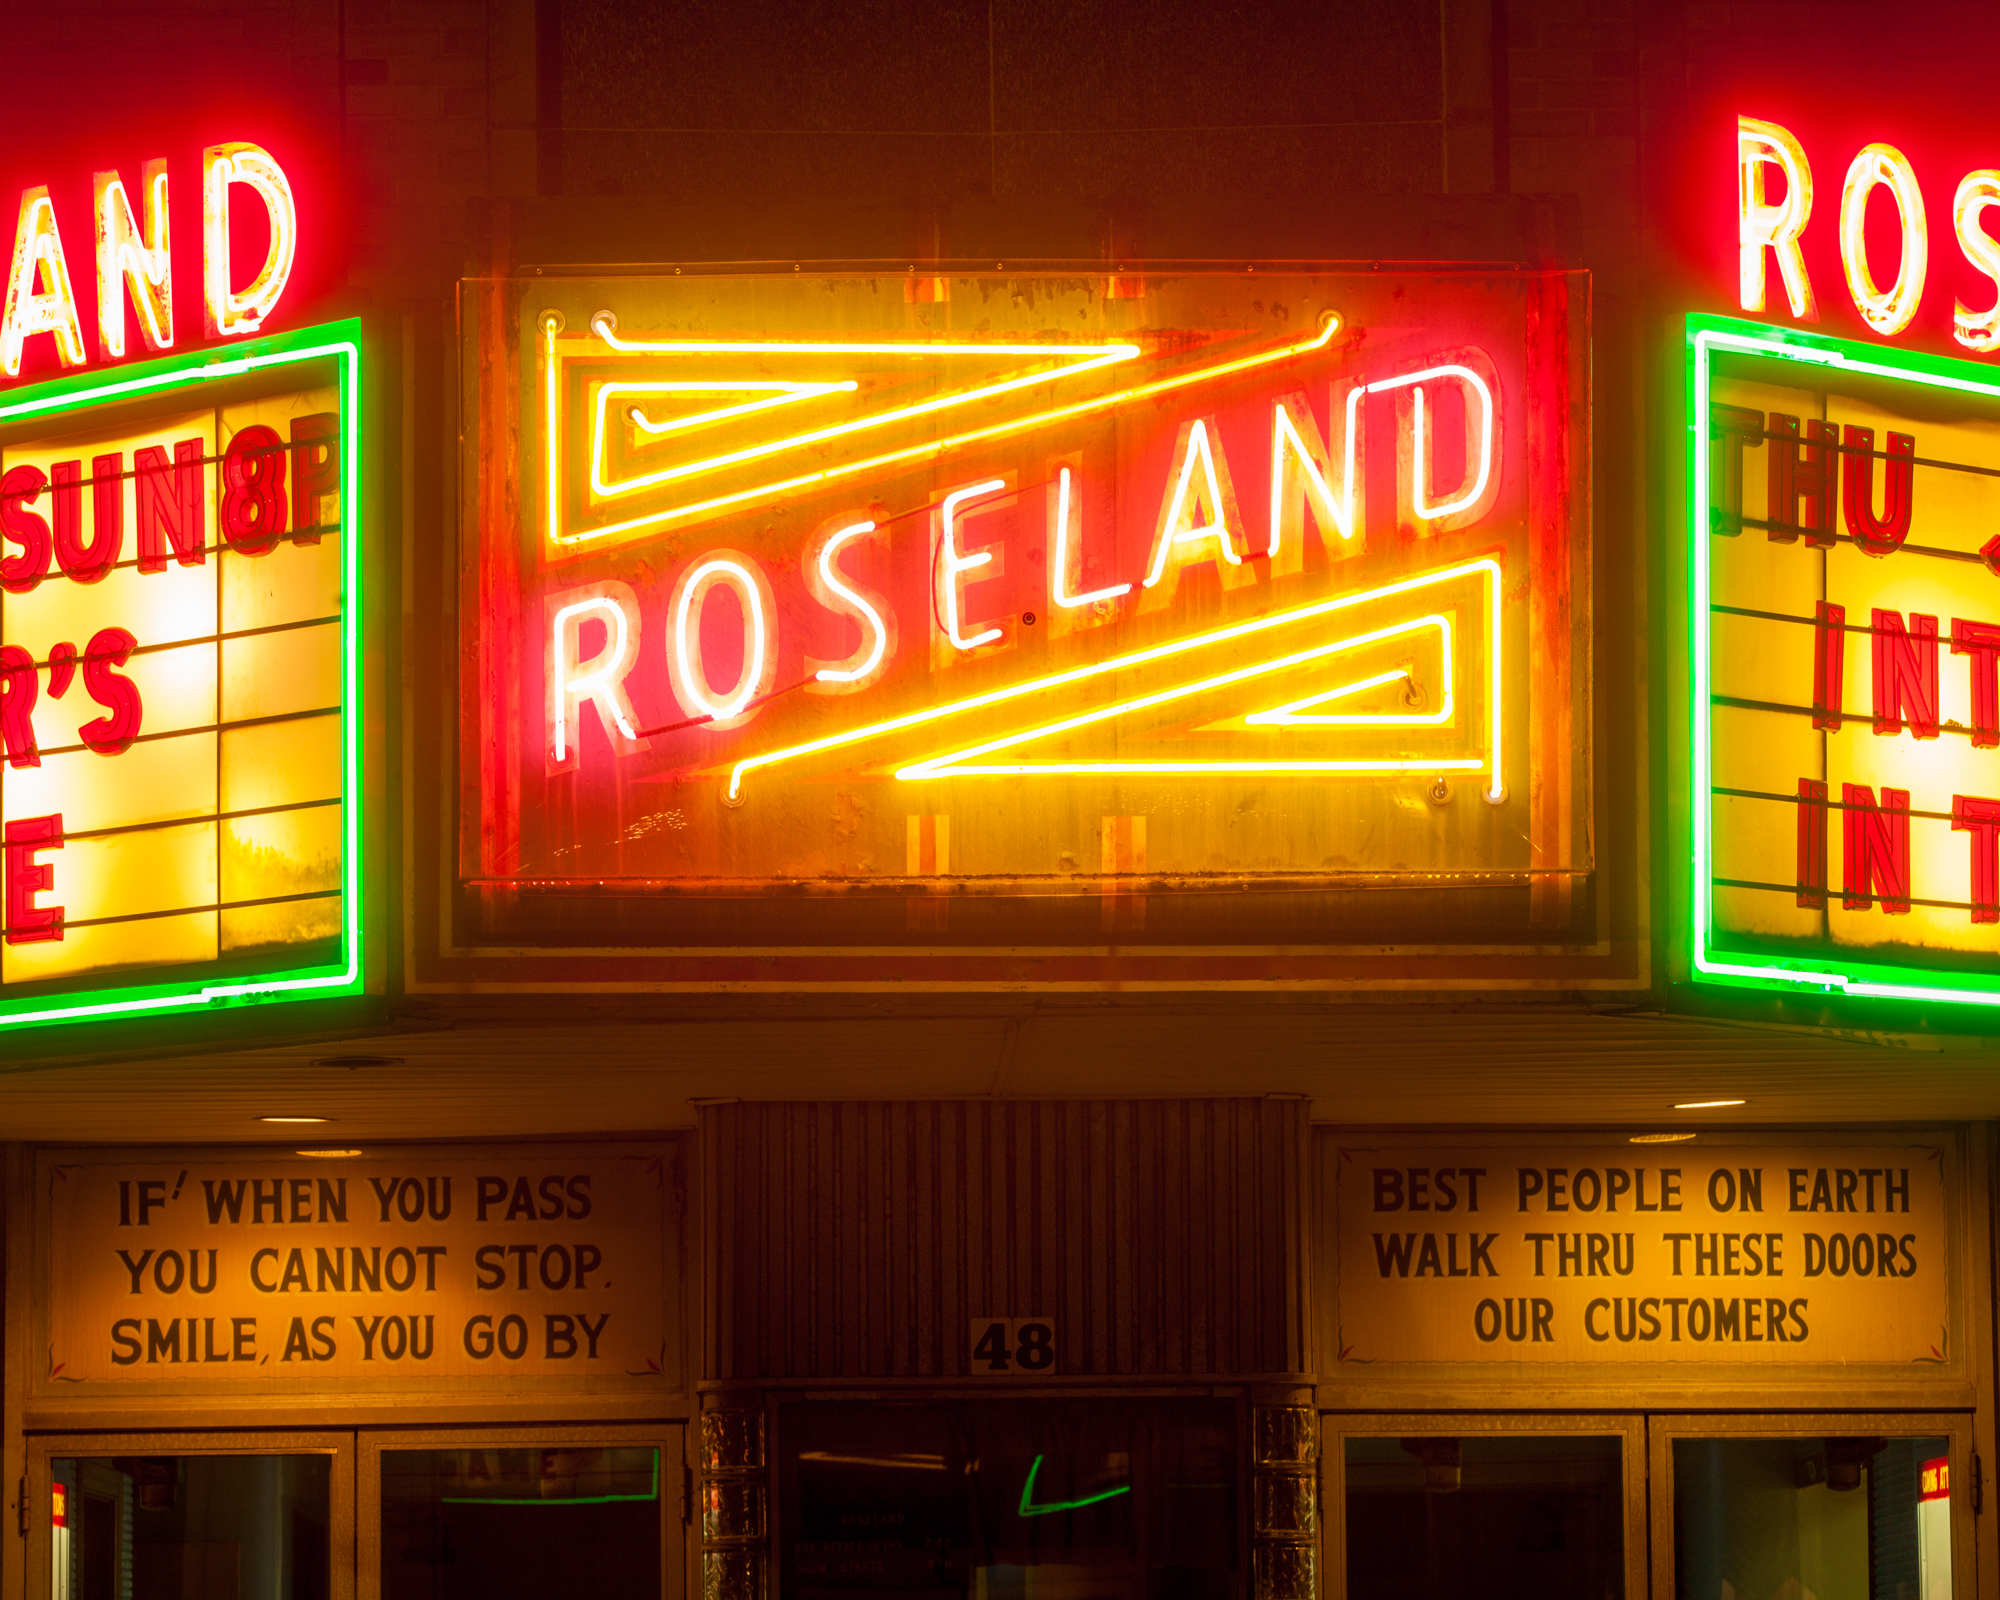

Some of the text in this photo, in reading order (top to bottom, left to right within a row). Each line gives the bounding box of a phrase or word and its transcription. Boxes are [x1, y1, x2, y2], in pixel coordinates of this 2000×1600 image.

[0, 141, 297, 377] AND
[1738, 114, 2000, 353] ROS
[1711, 402, 1915, 558] THU
[0, 437, 206, 594] SUN
[545, 345, 1502, 776] ROSELAND
[1813, 600, 2000, 750] INT
[1796, 777, 1911, 916] IN
[5, 812, 65, 946] E
[201, 1178, 349, 1224] WHEN
[372, 1176, 453, 1223] YOU
[475, 1174, 592, 1222] PASS
[1372, 1168, 1910, 1212] BEST PEOPLE ON EARTH
[116, 1244, 613, 1295] YOU CANNOT STOP.
[1372, 1233, 1917, 1277] WALK THRU THESE DOORS
[110, 1313, 611, 1365] SMILE, AS YOU GO BY
[1474, 1297, 1809, 1343] OUR CUSTOMERS
[973, 1323, 1055, 1370] 48
[840, 1513, 905, 1526] ROSELAND
[794, 1542, 815, 1554] BOX
[823, 1541, 865, 1552] OFFICE
[869, 1539, 903, 1551] OPENS
[795, 1562, 827, 1574] SHOW
[840, 1561, 884, 1573] STARTS
